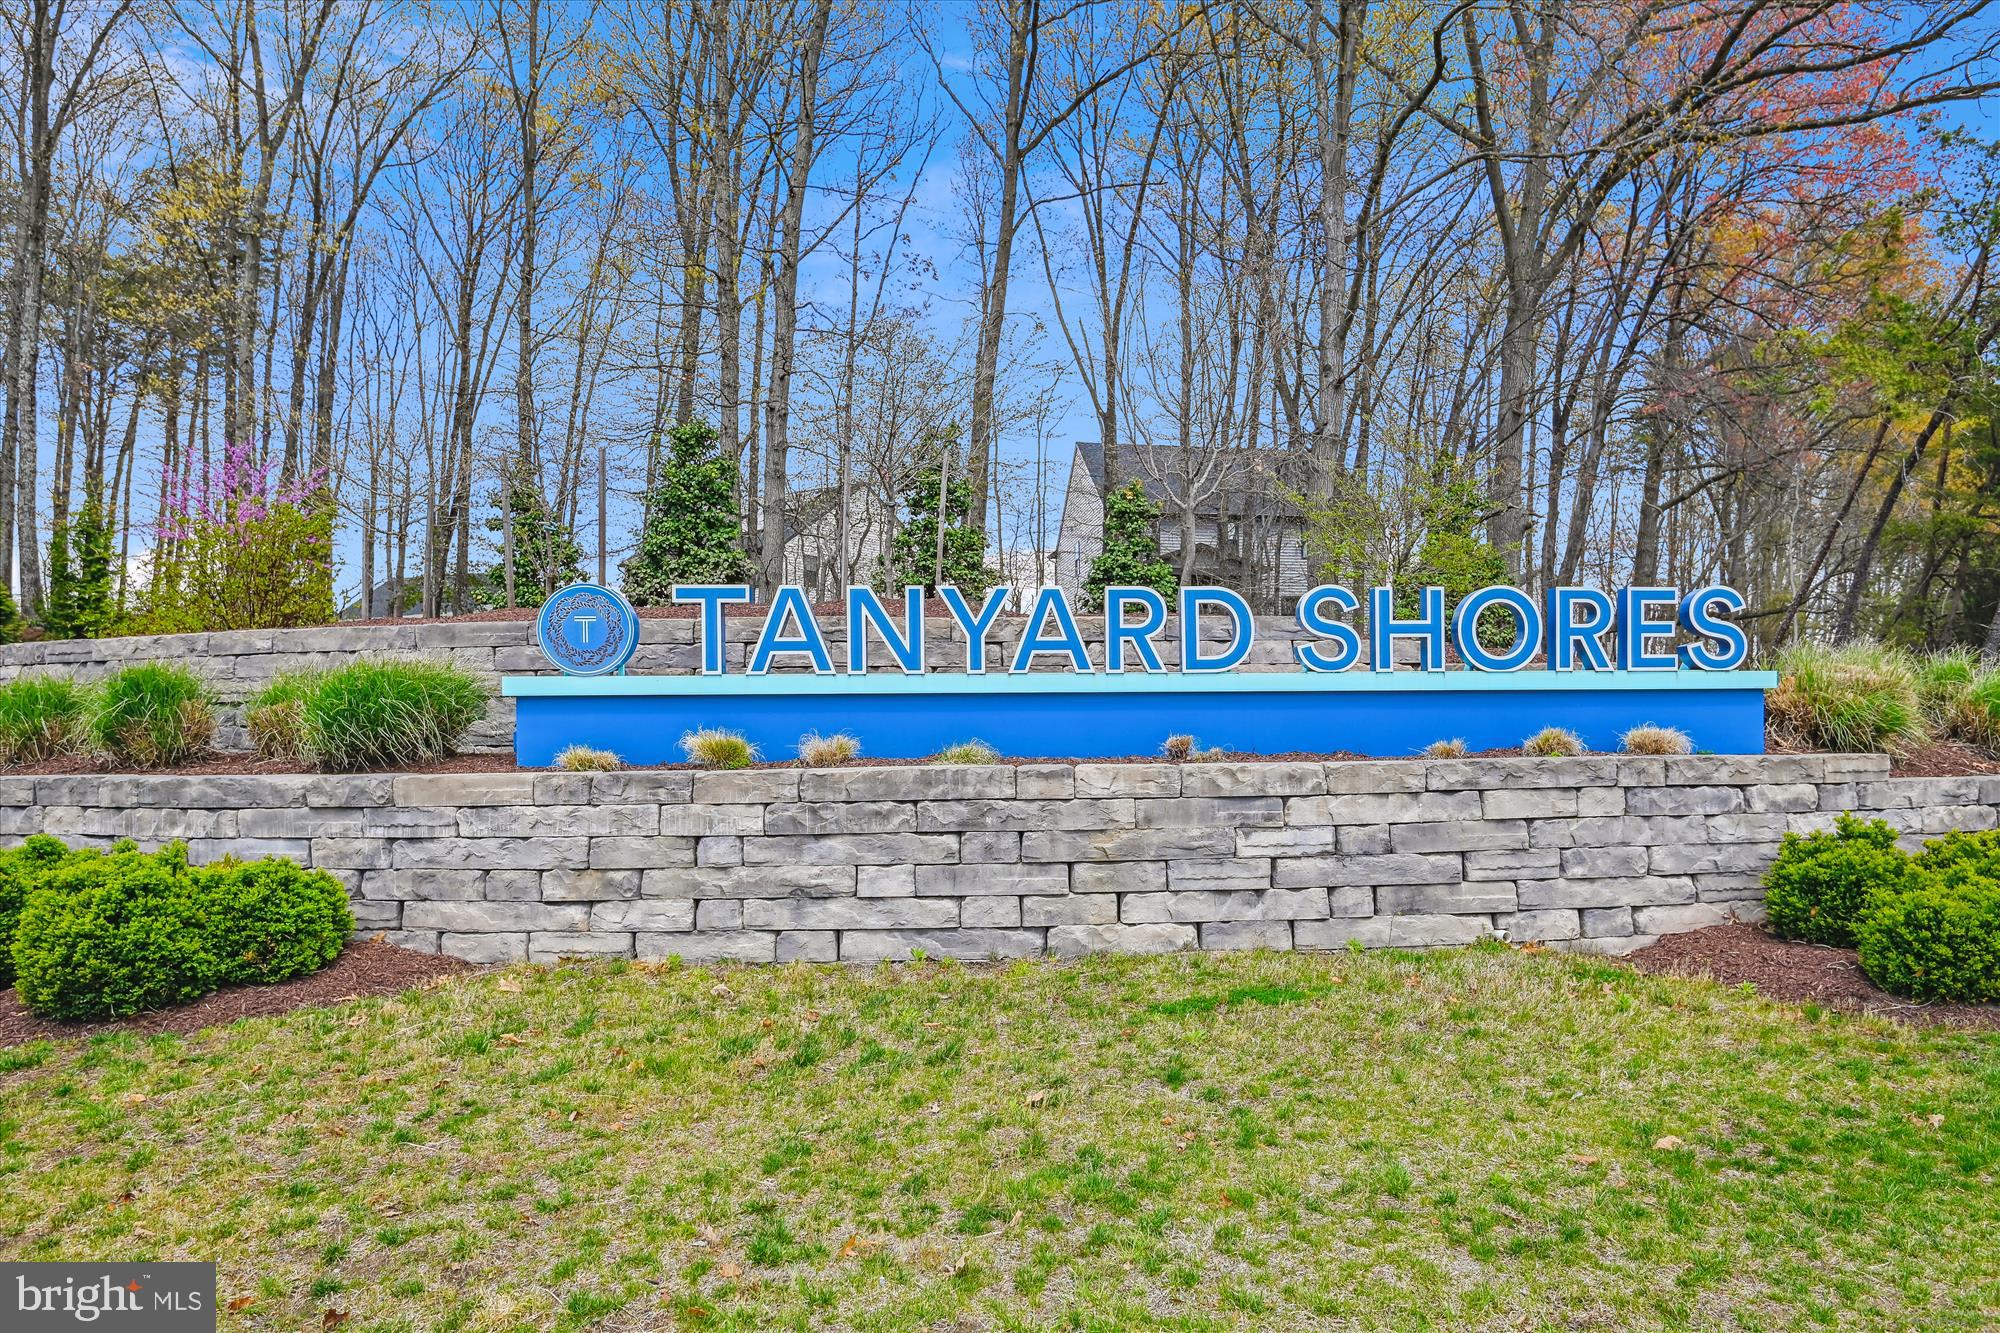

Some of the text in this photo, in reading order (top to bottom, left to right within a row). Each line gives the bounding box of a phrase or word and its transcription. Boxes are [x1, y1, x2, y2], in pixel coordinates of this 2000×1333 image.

[573, 615, 597, 643] T
[672, 584, 1748, 675] TANYARD SHORES
